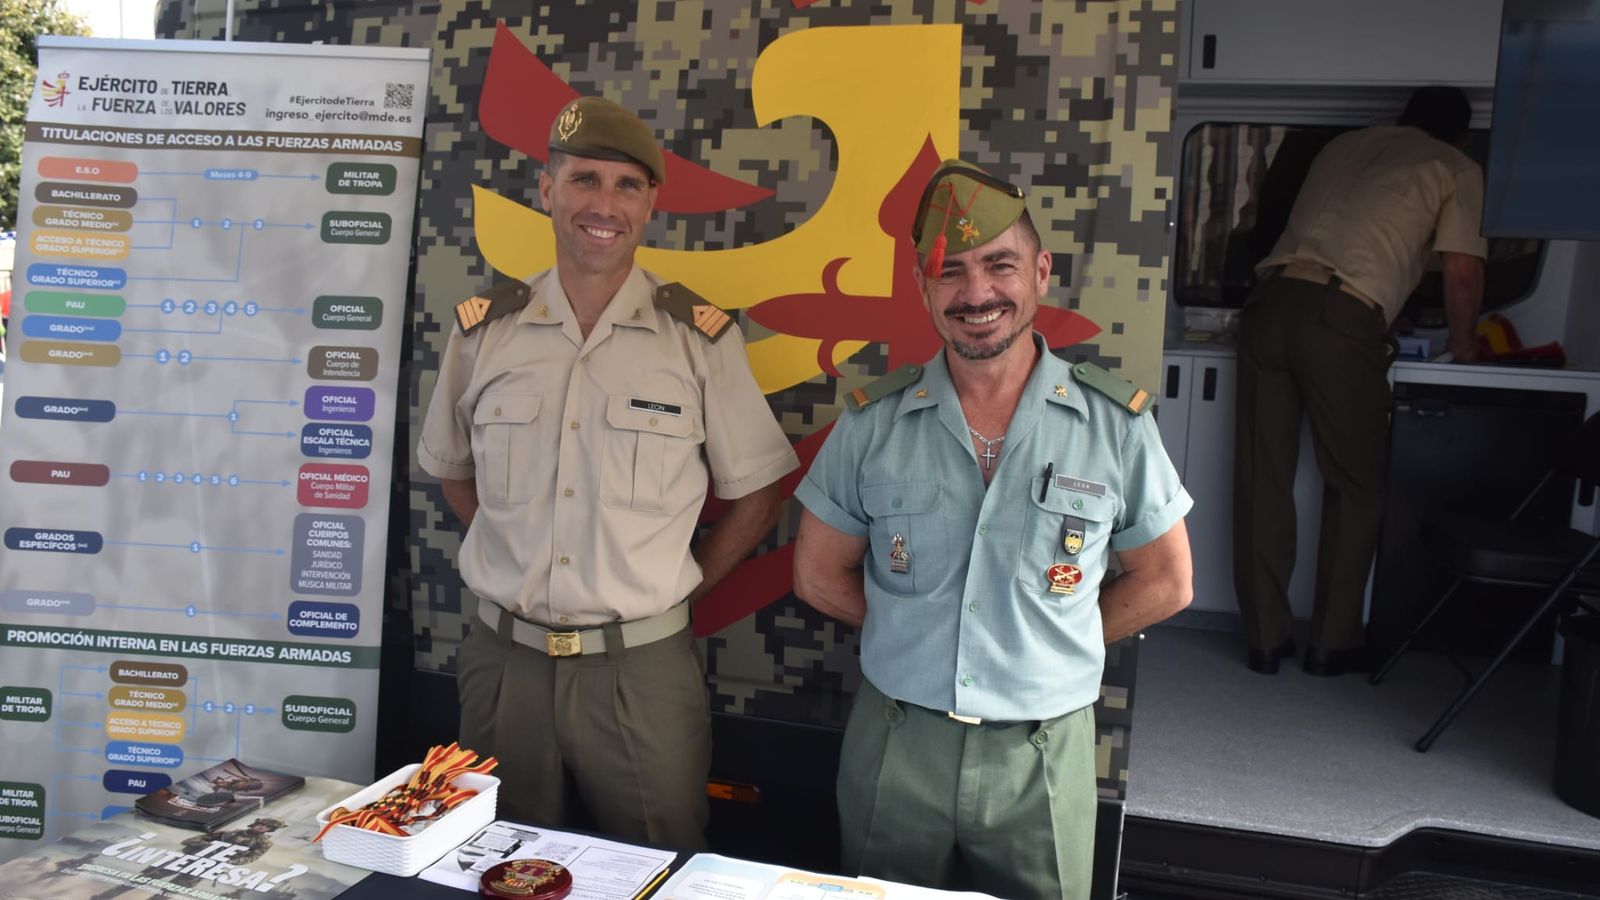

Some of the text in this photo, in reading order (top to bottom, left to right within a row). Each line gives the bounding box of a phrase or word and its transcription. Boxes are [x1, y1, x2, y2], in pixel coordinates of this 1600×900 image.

[78, 74, 158, 94] EJÉRCITO
[92, 97, 156, 114] FUERZA
[289, 96, 375, 107] #EjercitodeTierra
[174, 101, 246, 116] VALORES
[265, 108, 412, 124] ingreso_ejercito@mde.es
[41, 127, 403, 151] TITULACIONES DE ACCESO A LAS FUERZAS ARMADAS
[343, 171, 379, 180] MILITAR
[352, 180, 383, 188] TROPA
[51, 190, 121, 201] BACHILLERATO
[62, 210, 104, 220] TÉCNICO
[45, 218, 79, 227] GRADO
[329, 220, 383, 229] SUBOFICIAL
[331, 228, 381, 238] Cuerpo General
[56, 268, 98, 278] TÉCNICO
[32, 276, 65, 284] GRADO
[65, 300, 85, 309] PAU
[164, 302, 254, 314] 1 2 3 4 5
[330, 305, 366, 313] OFICIAL
[322, 313, 372, 322] Cuerpo General
[159, 352, 188, 362] 1 2
[325, 351, 361, 360] OFICIAL
[326, 360, 360, 368] Cuerpo de
[323, 368, 360, 377] Intendencia
[322, 396, 358, 404] OFICIAL
[322, 405, 356, 414] Ingenieros
[318, 428, 354, 437] OFICIAL
[303, 436, 370, 446] ESCALA TÉCNICA
[318, 446, 352, 455] Ingenieros
[51, 470, 70, 478] PAU
[300, 472, 368, 482] OFICIAL MÉDICO
[310, 482, 355, 491] Cuerpo Militar
[324, 492, 350, 500] Sanidad
[312, 521, 346, 530] OFICIAL
[34, 532, 74, 542] GRADOS
[308, 530, 349, 539] CUERPOS
[306, 538, 352, 548] COMUNES:
[312, 550, 342, 560] SANIDAD
[311, 560, 342, 570] JURÍDICO
[302, 570, 351, 580] INTERVENCIÓN
[298, 580, 352, 590] MÚSICA MILITAR
[300, 610, 348, 620] OFICIAL DE
[289, 620, 358, 630] COMPLEMENTO
[7, 630, 352, 663] PROMOCIÓN INTERNA EN LAS FUERZAS ARMADAS
[118, 669, 178, 680] BACHILLERATO
[128, 690, 165, 700] TÉCNICO
[6, 696, 43, 705] MILITAR
[114, 699, 144, 707] GRADO
[16, 706, 46, 714] TROPA
[284, 704, 352, 716] SUBOFICIAL
[288, 714, 350, 725] Cuerpo General
[128, 746, 161, 755] TÉCNICO
[108, 754, 136, 762] GRADO
[128, 780, 146, 788] PAU
[2, 789, 34, 798] MILITAR
[11, 798, 38, 808] TROPA
[0, 815, 41, 825] UBOFICIAL
[196, 840, 250, 862] TE
